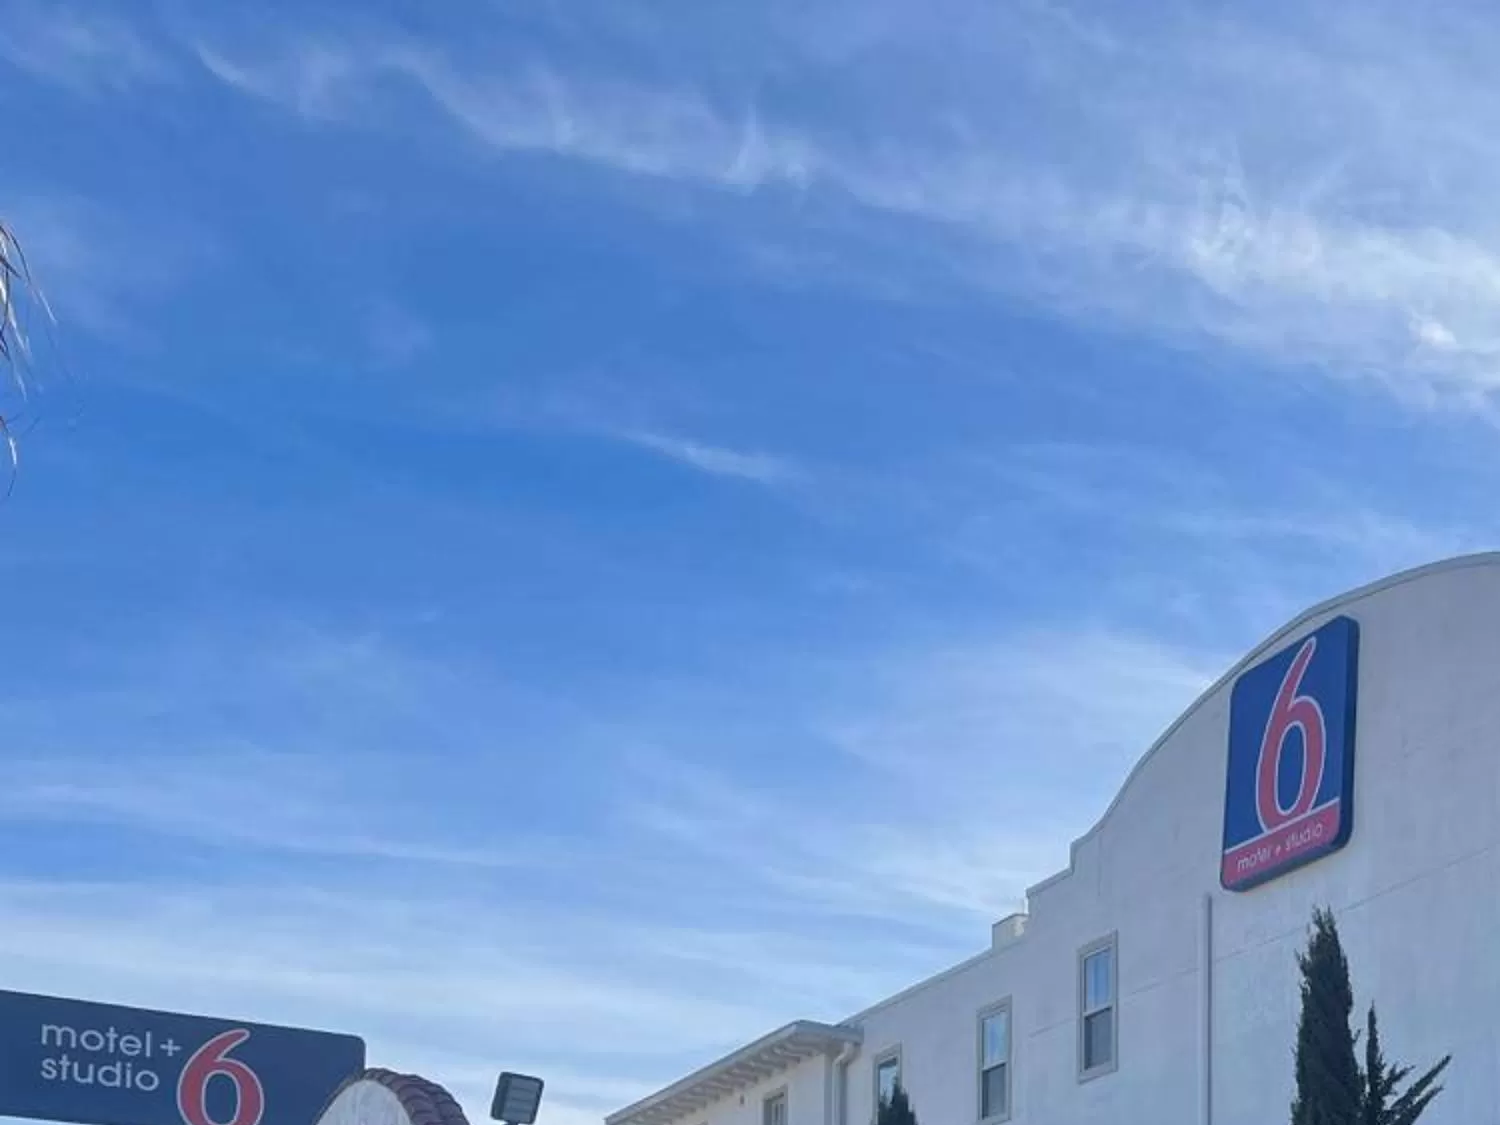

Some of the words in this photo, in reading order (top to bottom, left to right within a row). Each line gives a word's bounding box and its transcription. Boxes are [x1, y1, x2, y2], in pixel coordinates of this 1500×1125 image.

[1256, 636, 1326, 834] 6
[40, 1022, 151, 1058] motel
[40, 1054, 160, 1092] studio
